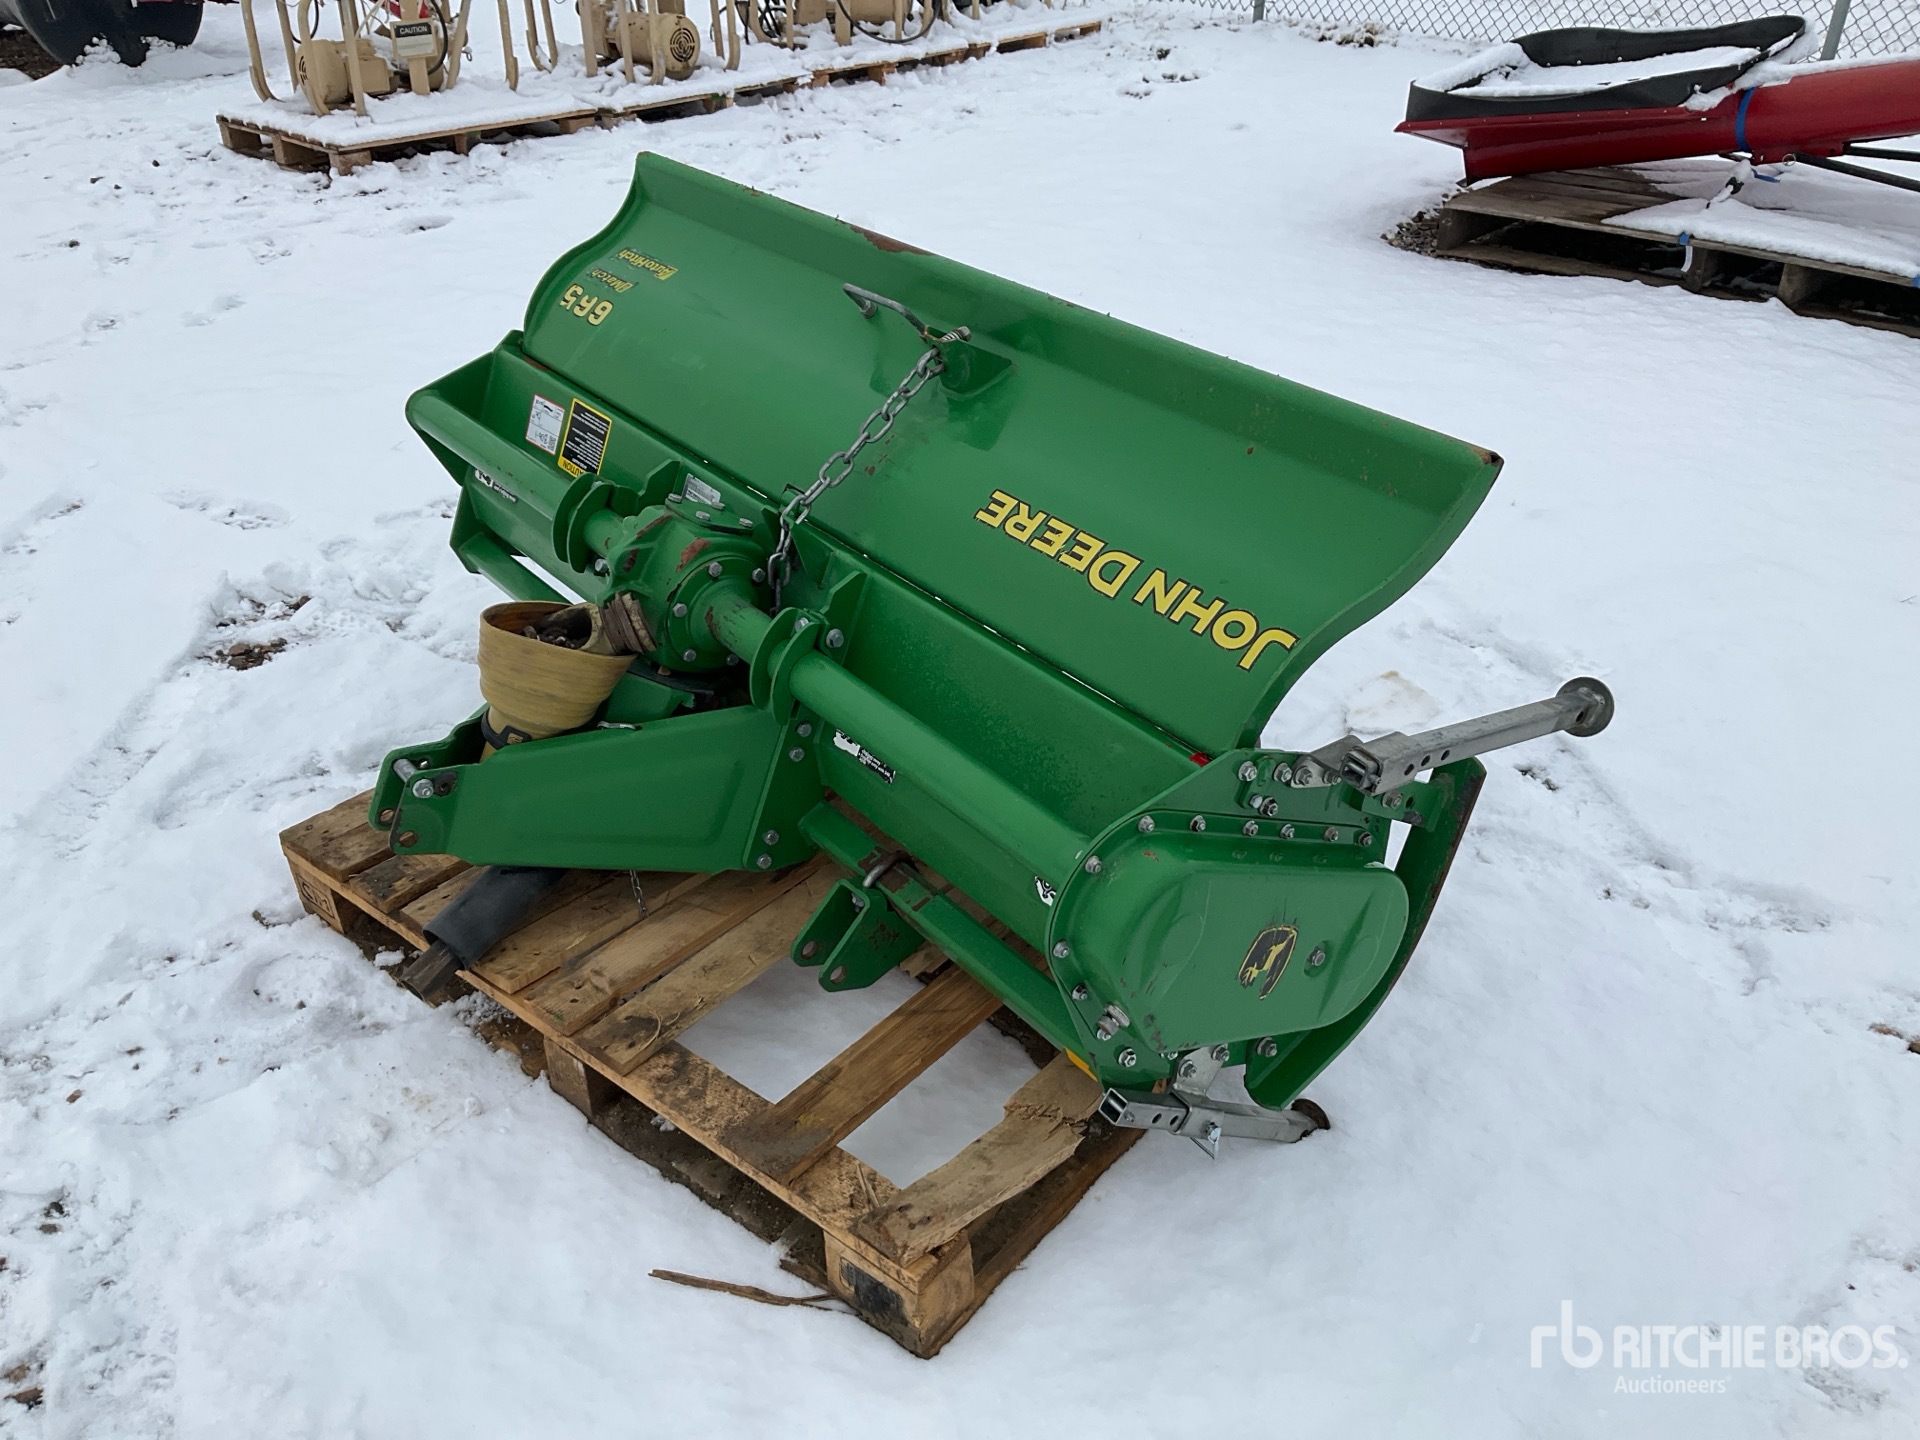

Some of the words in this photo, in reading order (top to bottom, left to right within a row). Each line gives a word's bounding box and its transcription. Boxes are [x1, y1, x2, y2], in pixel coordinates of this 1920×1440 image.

[399, 25, 428, 35] CAUTION
[619, 249, 678, 280] AutoHitch
[974, 488, 1144, 599] DEERE
[1132, 567, 1300, 672] JOHN
